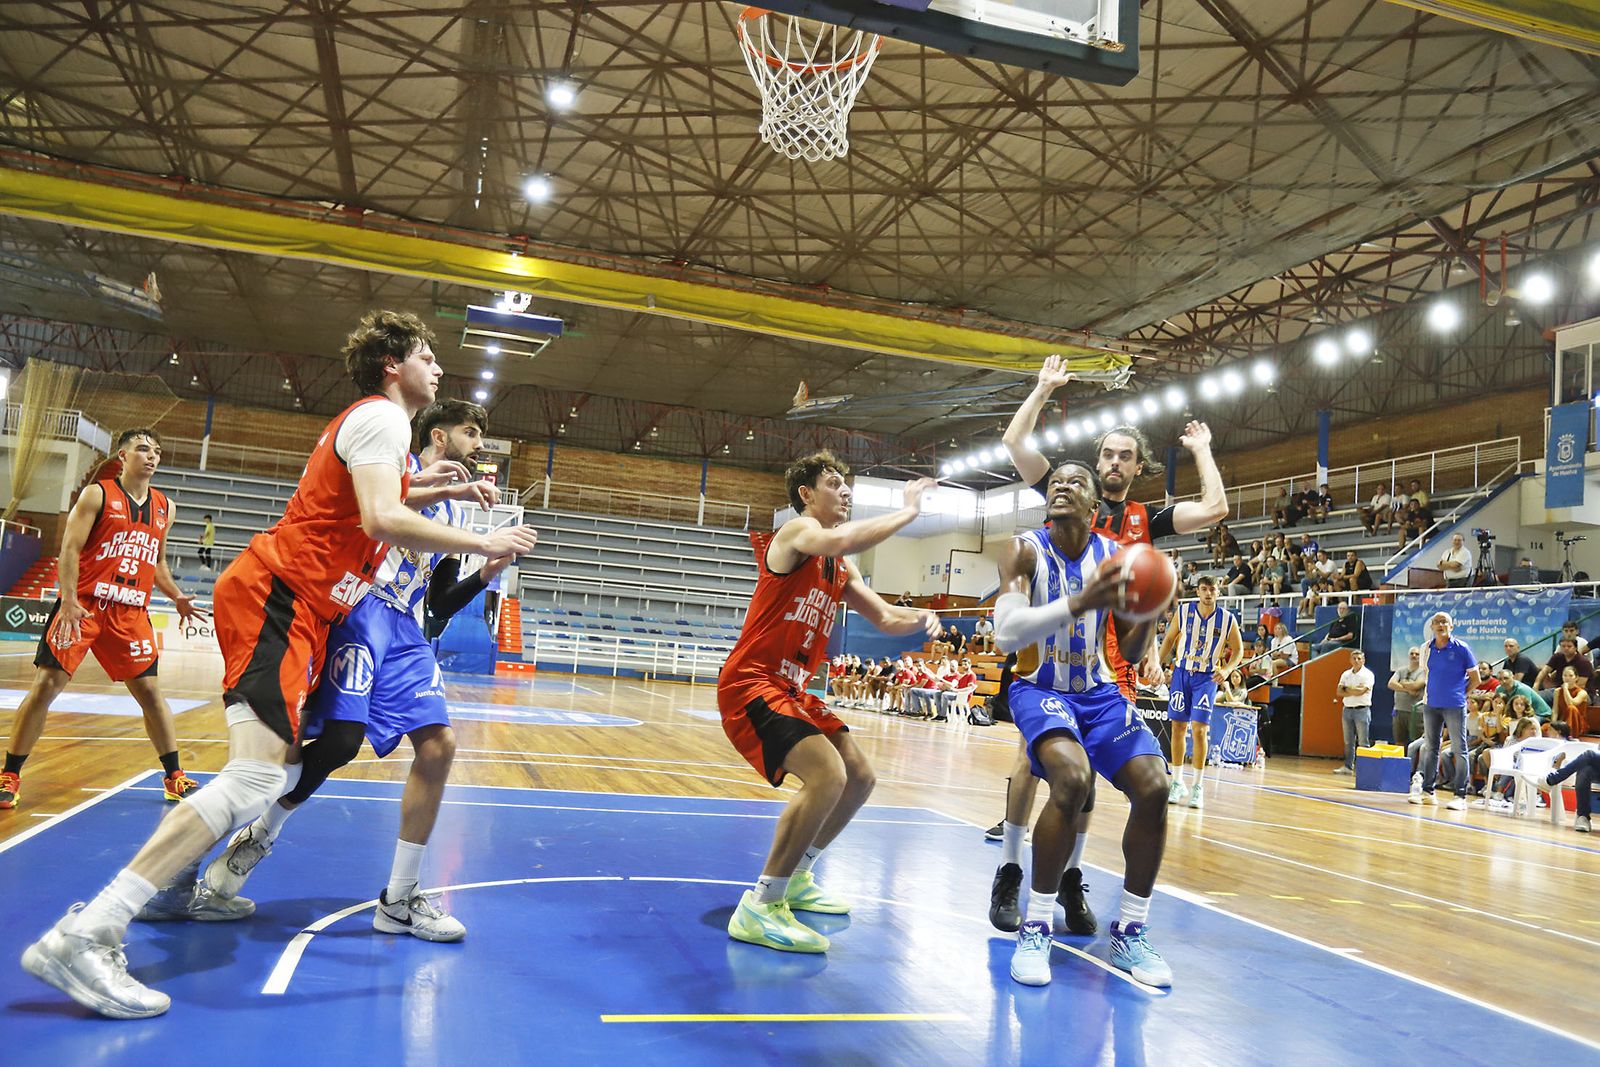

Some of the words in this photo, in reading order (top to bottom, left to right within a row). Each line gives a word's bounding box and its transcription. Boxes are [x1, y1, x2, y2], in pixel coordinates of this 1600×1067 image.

[1530, 541, 1543, 550] 114
[118, 558, 140, 575] 55
[1452, 617, 1508, 627] Ayuntamiento
[1466, 626, 1478, 634] de
[1479, 626, 1507, 634] Huelva
[129, 639, 152, 656] 55
[414, 690, 435, 699] Junta
[1113, 730, 1131, 742] Junta
